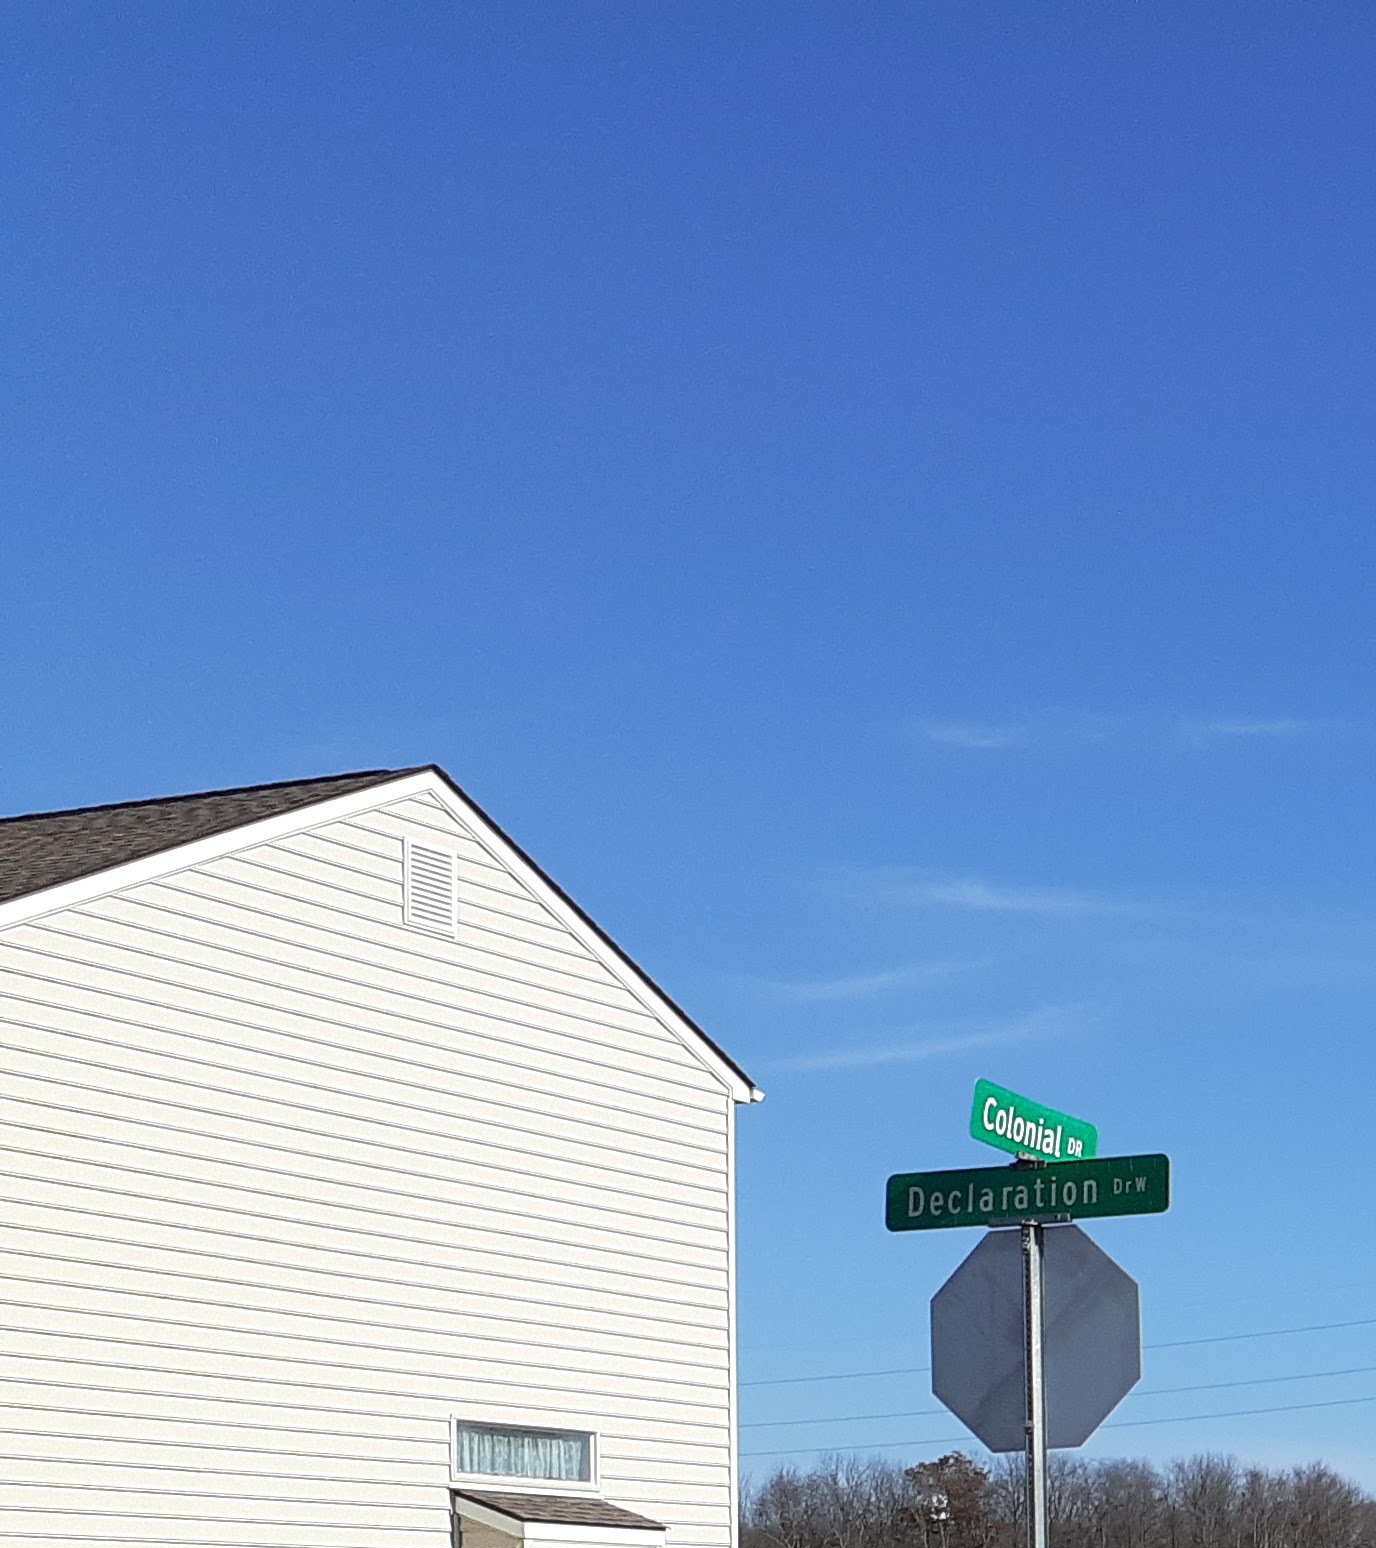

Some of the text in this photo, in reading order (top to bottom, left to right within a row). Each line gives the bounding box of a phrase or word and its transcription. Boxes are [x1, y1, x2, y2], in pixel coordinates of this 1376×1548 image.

[983, 1097, 1083, 1158] Colonial DR
[908, 1176, 1097, 1218] Declaration
